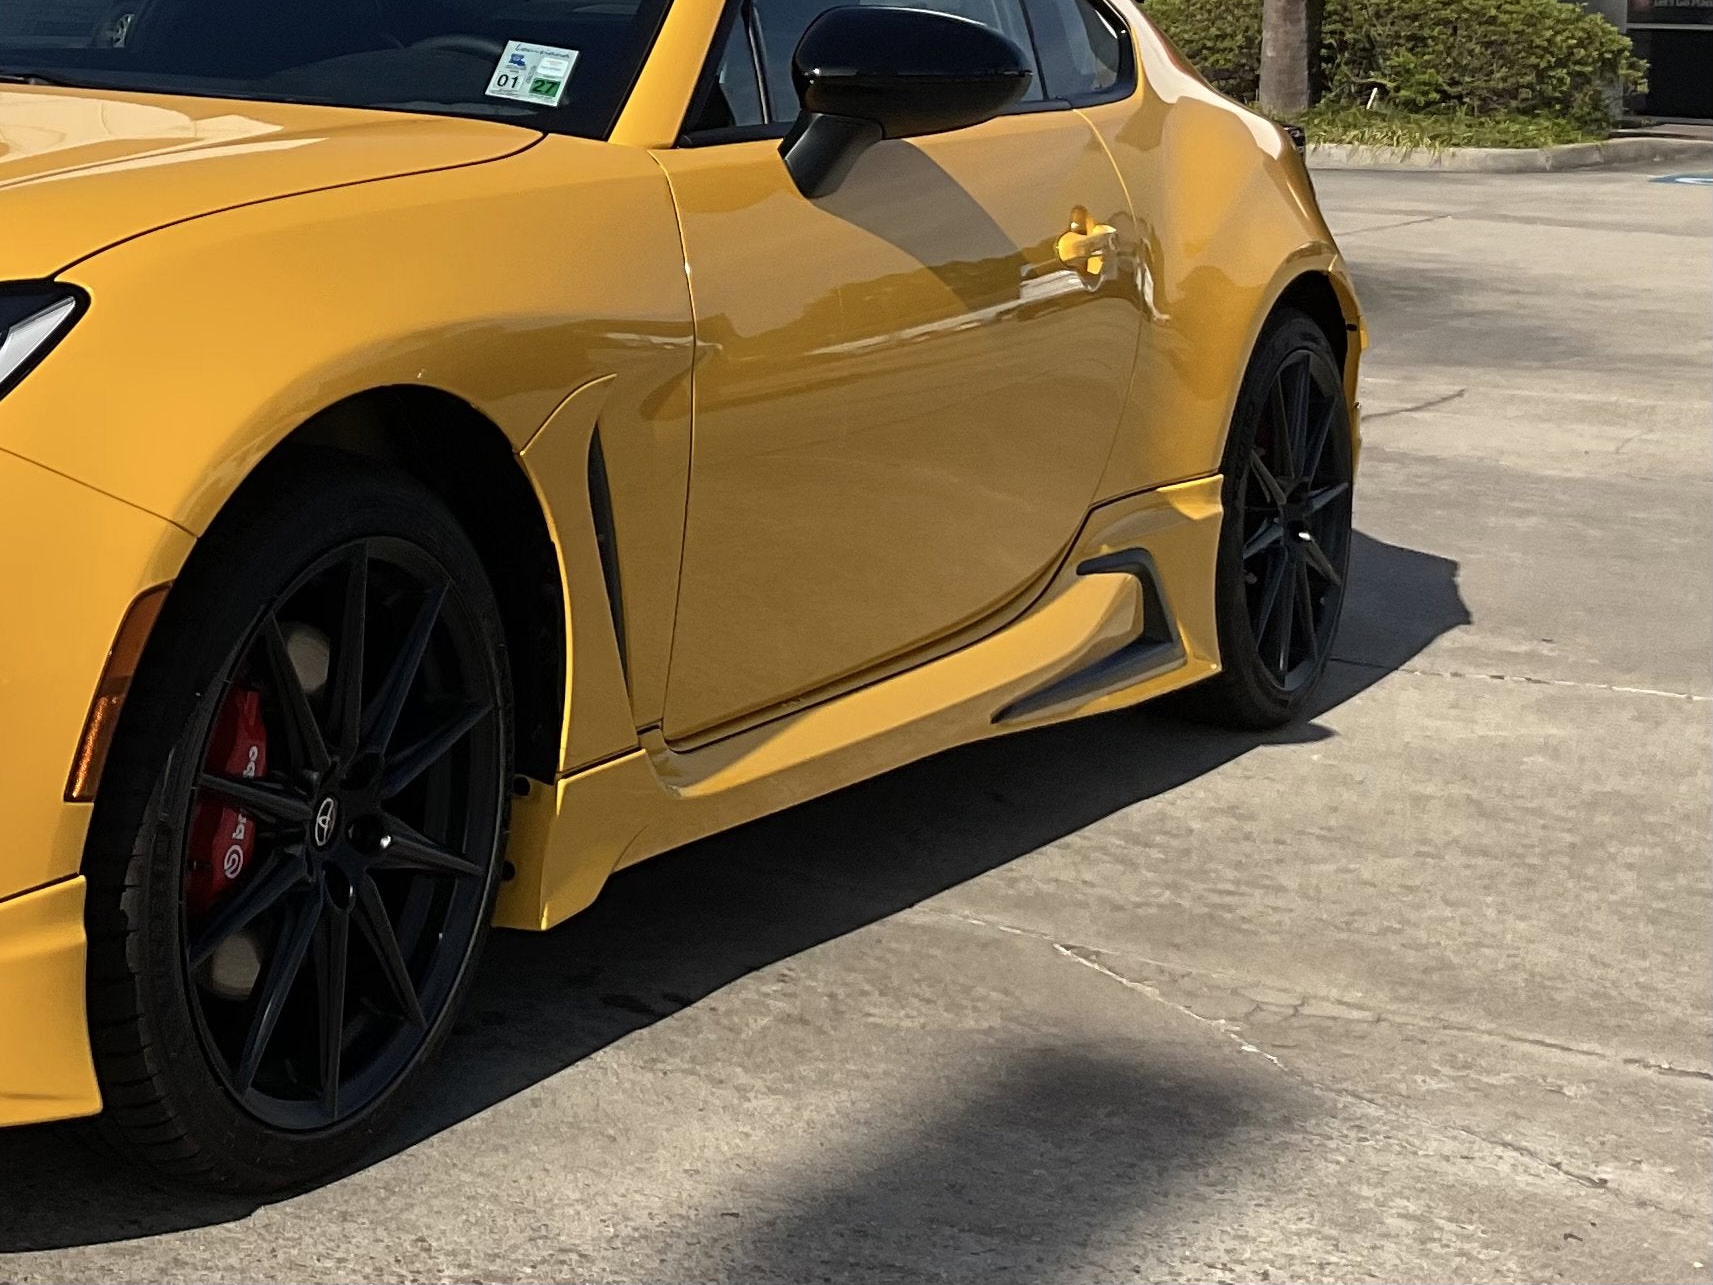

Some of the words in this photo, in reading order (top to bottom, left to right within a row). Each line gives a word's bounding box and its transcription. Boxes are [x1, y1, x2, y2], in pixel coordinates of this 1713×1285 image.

[497, 74, 519, 89] 01
[532, 78, 562, 94] 27
[231, 745, 259, 840] brbo
